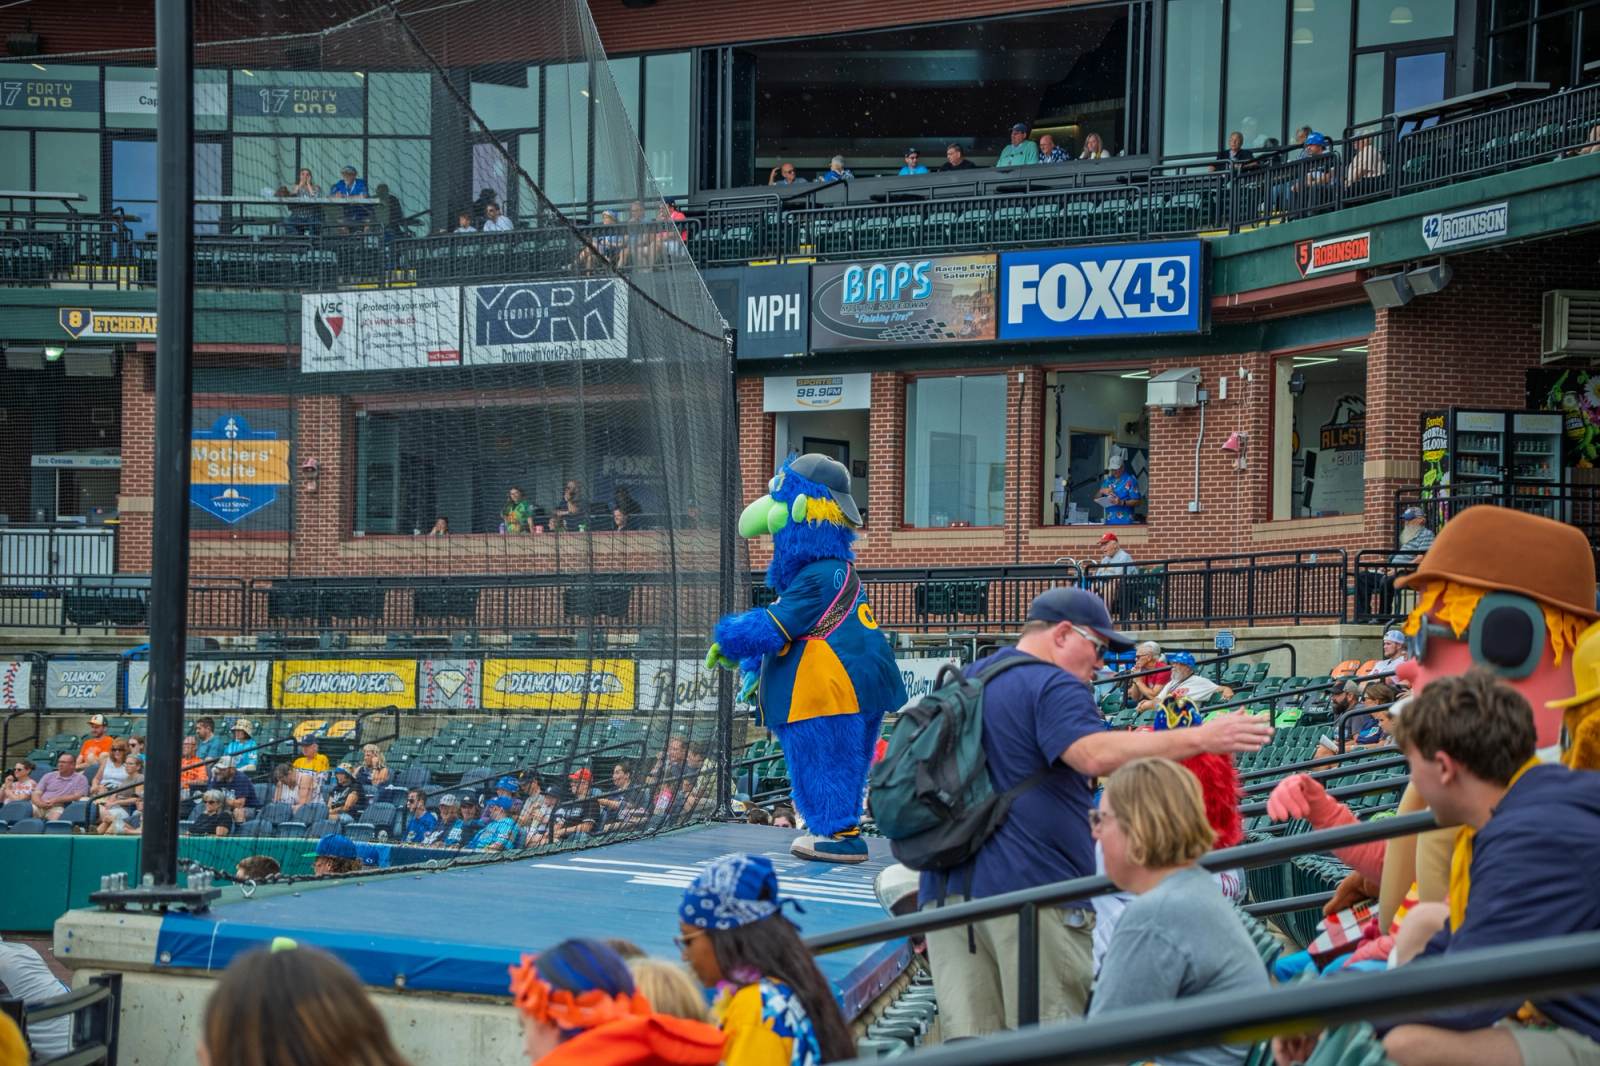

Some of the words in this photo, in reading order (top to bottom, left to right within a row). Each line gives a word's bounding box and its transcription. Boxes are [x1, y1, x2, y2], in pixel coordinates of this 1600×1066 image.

[0, 81, 23, 106] 7
[27, 82, 73, 95] FORTY
[293, 89, 337, 101] FORTY
[27, 96, 73, 108] one
[260, 89, 290, 113] 17
[293, 103, 337, 114] one
[1423, 217, 1439, 238] 42
[1443, 206, 1506, 243] ROBINSON
[1299, 243, 1309, 265] 5
[1313, 236, 1369, 268] ROBINSON
[935, 264, 968, 273] Racing
[970, 262, 998, 272] Every
[943, 269, 990, 280] Saturday!
[842, 260, 934, 304] BAPS
[320, 302, 343, 314] VSC
[363, 302, 400, 313] Protecting
[476, 280, 615, 345] YORK
[746, 293, 800, 333] MPH
[68, 310, 83, 328] 8
[207, 462, 257, 478] Suite
[60, 671, 107, 683] DIAMOND
[297, 672, 357, 693] DIAMOND
[358, 672, 391, 693] DECK
[507, 673, 572, 693] DIAMOND
[572, 673, 609, 693] DCK
[67, 684, 98, 699] DECK
